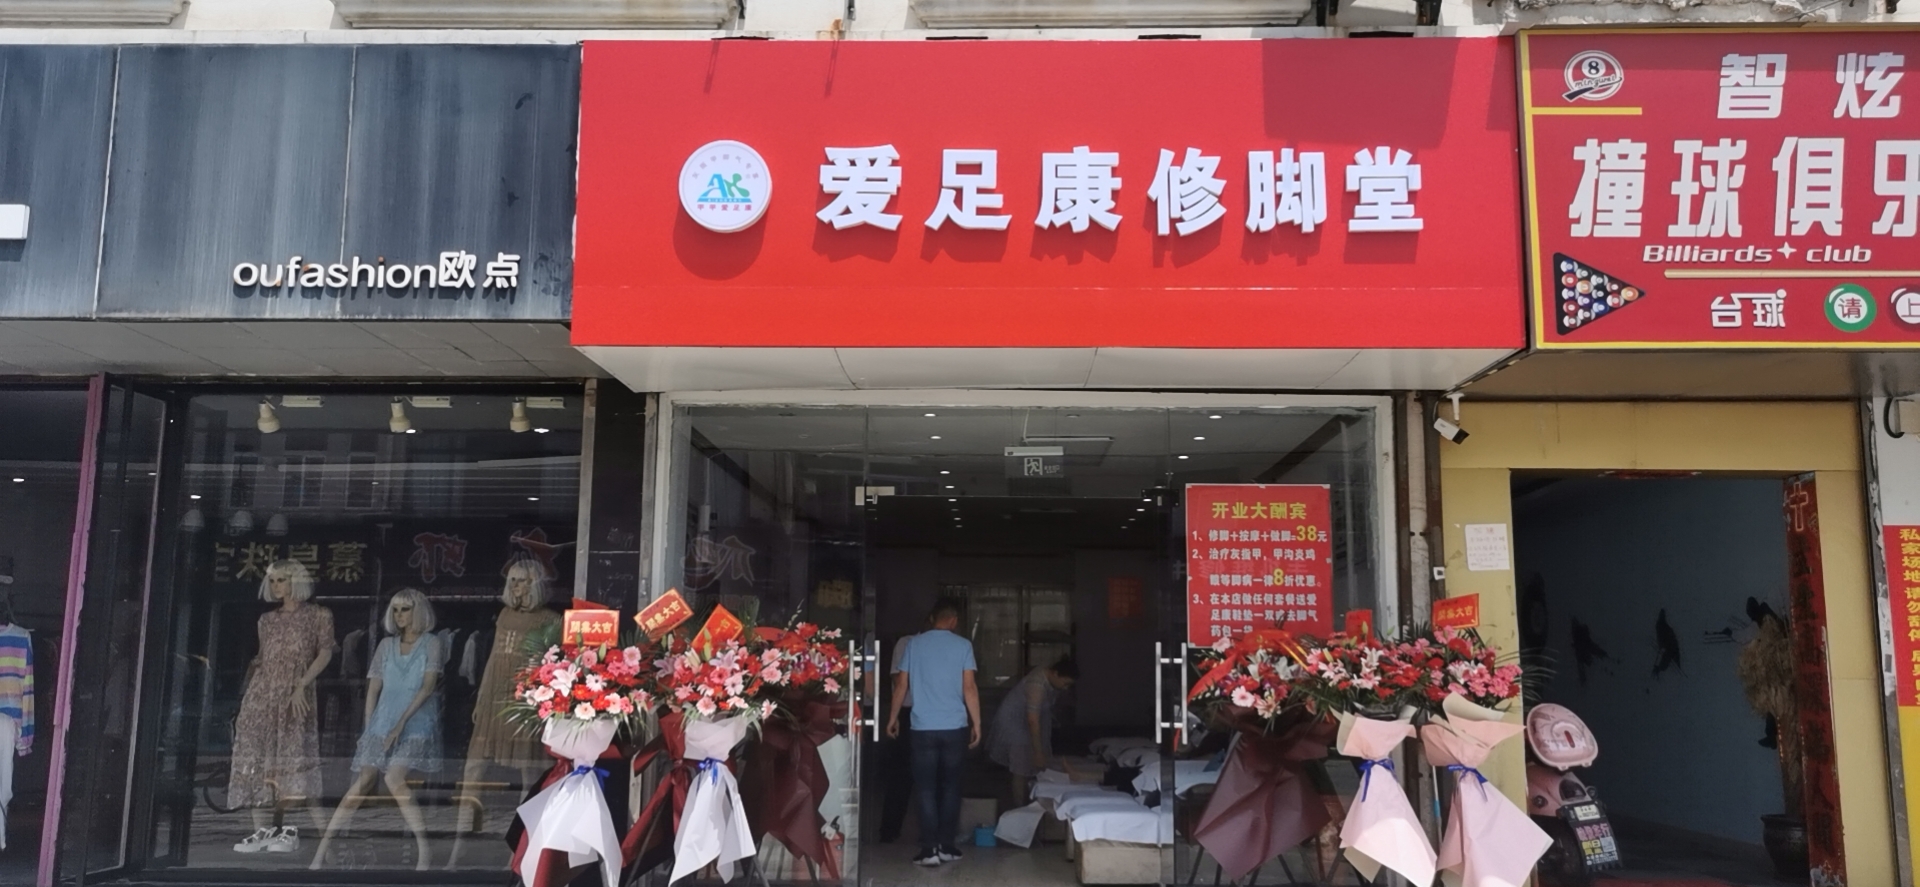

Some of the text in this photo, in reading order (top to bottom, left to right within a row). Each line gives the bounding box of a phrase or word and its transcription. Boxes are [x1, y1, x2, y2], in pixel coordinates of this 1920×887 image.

[1587, 60, 1600, 75] 8
[1717, 51, 1905, 119] 智炫
[816, 144, 1424, 236] 爱足康修脚堂
[1568, 136, 1920, 238] 撞球俱乐
[1643, 245, 1872, 263] Billiards club
[1711, 289, 1787, 329] 台球
[1838, 298, 1863, 319] 请
[1211, 502, 1308, 520] 开业大酬宾
